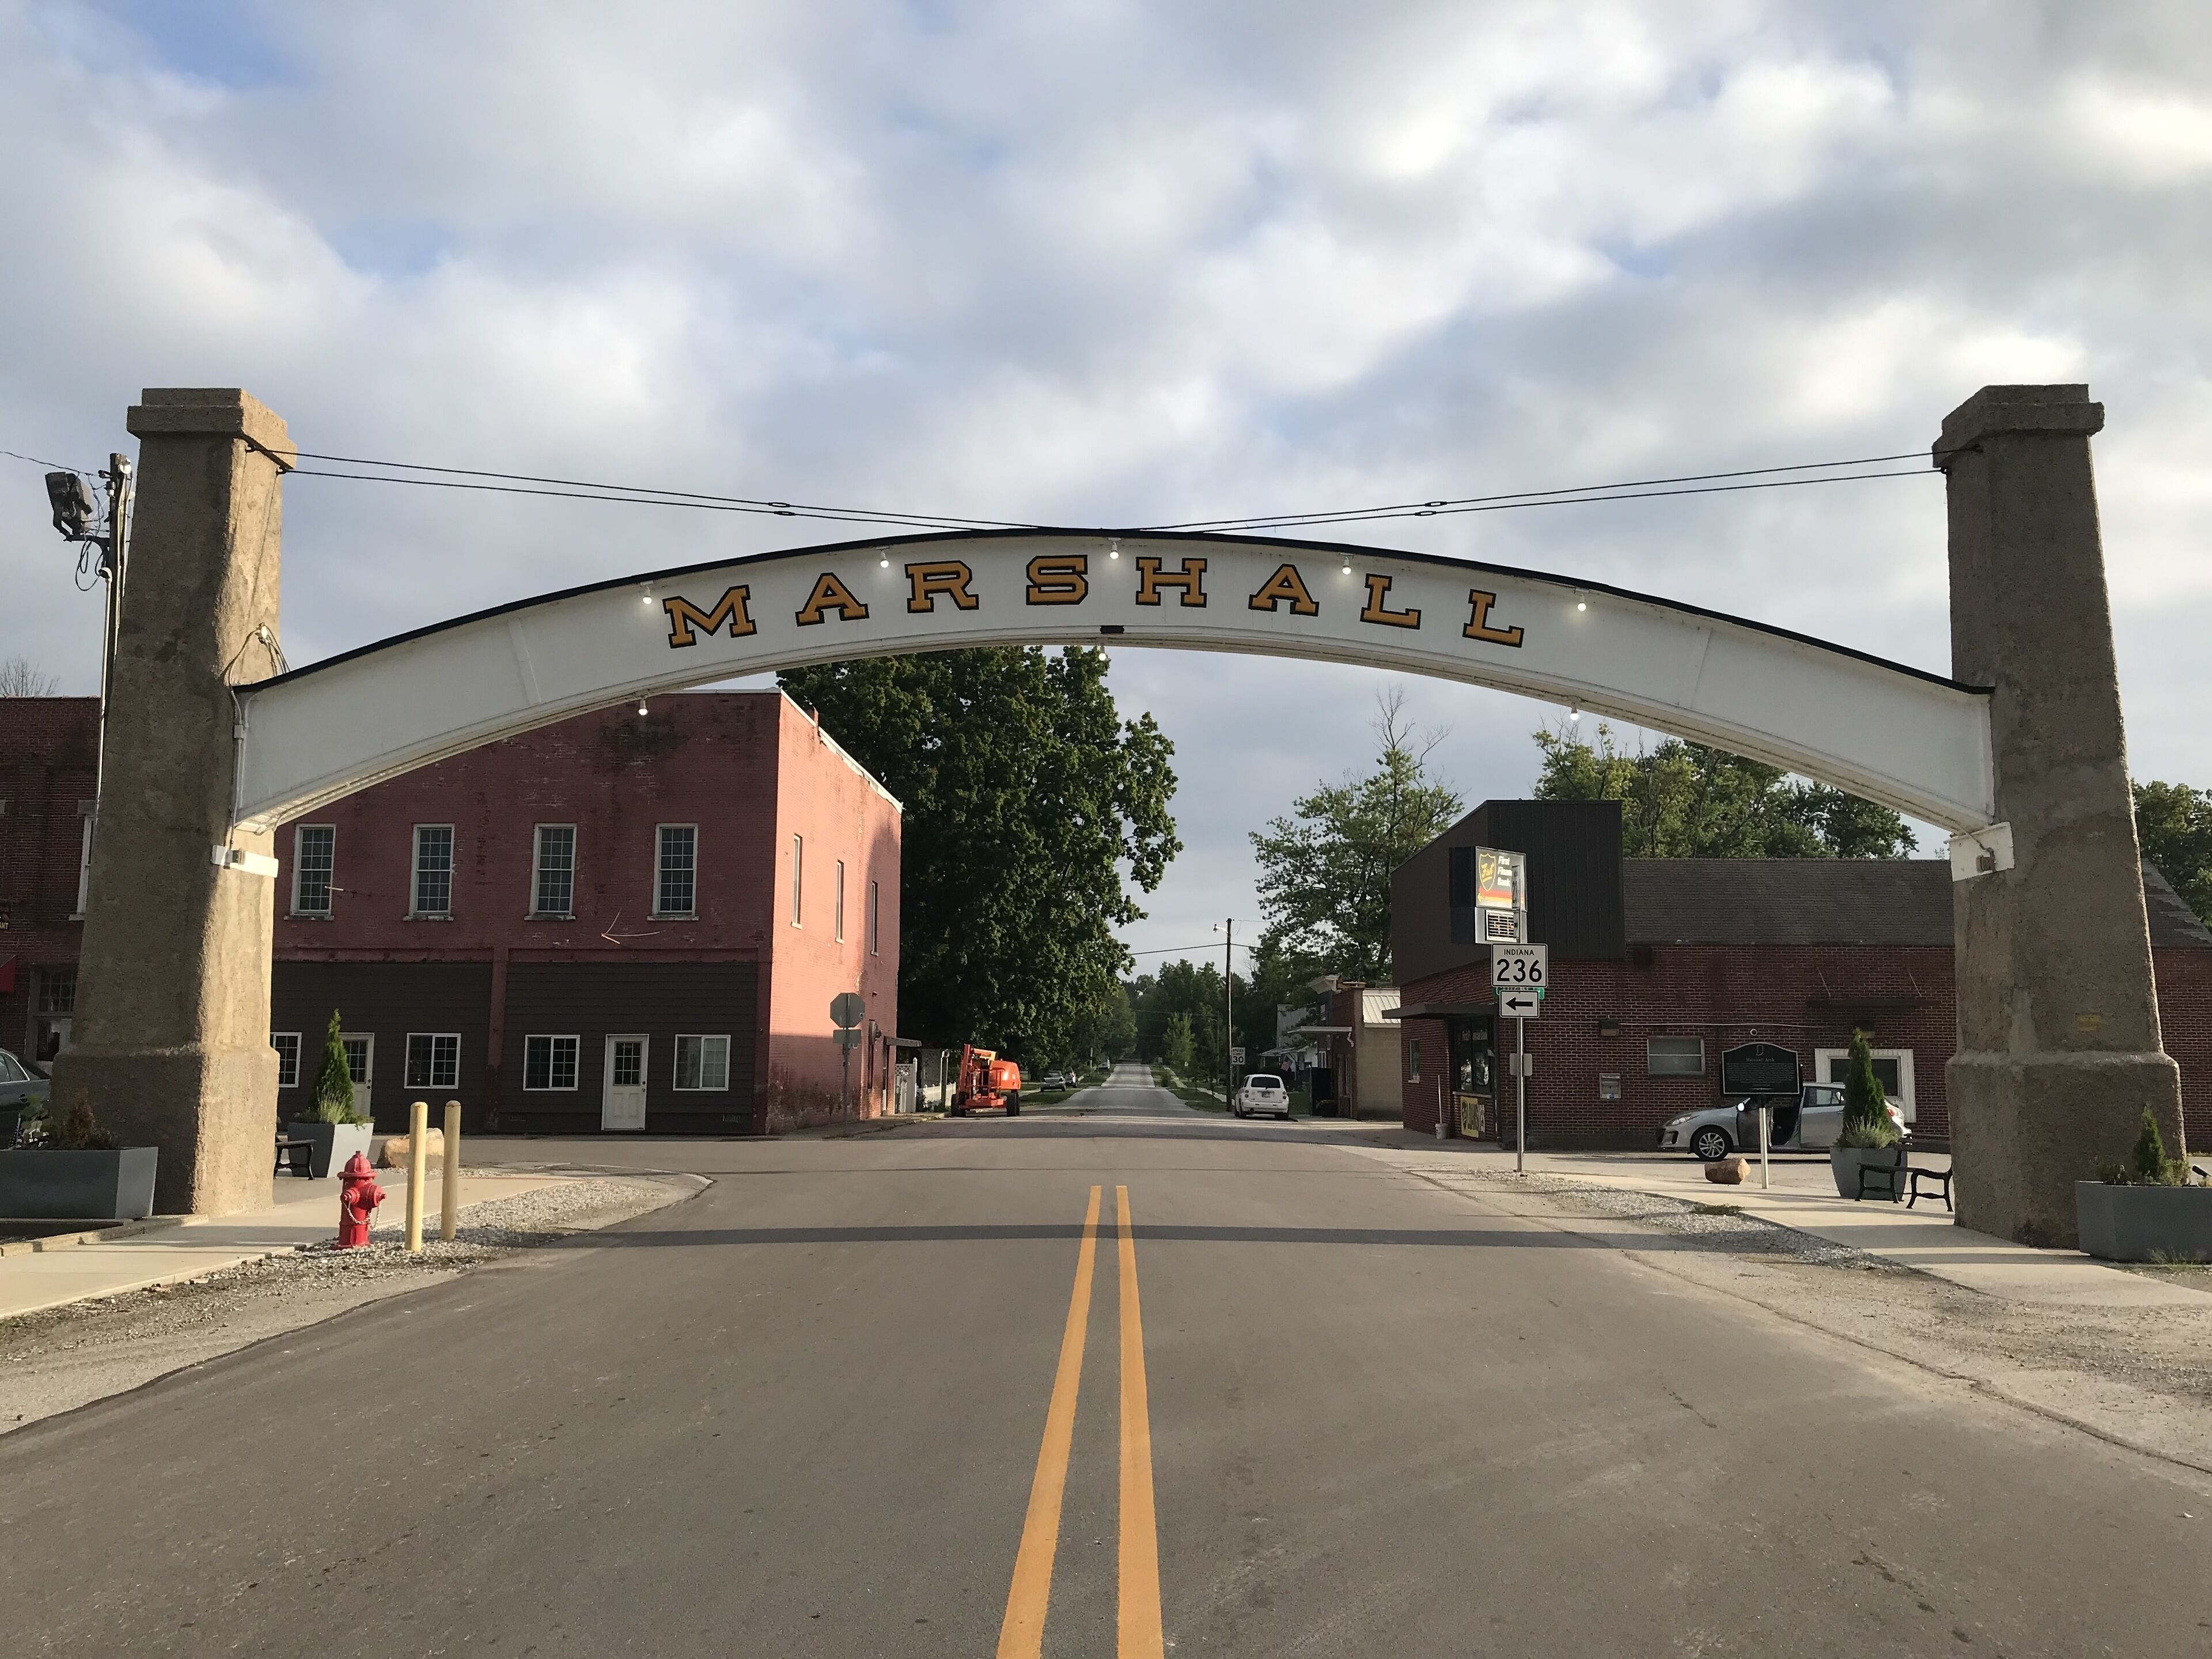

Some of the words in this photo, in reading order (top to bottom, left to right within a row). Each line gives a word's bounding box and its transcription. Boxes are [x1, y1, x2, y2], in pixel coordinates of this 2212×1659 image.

[662, 554, 1524, 649] MARSHALL
[1498, 855, 1510, 865] First
[1498, 866, 1513, 876] Finan
[1498, 877, 1510, 887] Bank
[1497, 959, 1542, 983] 236
